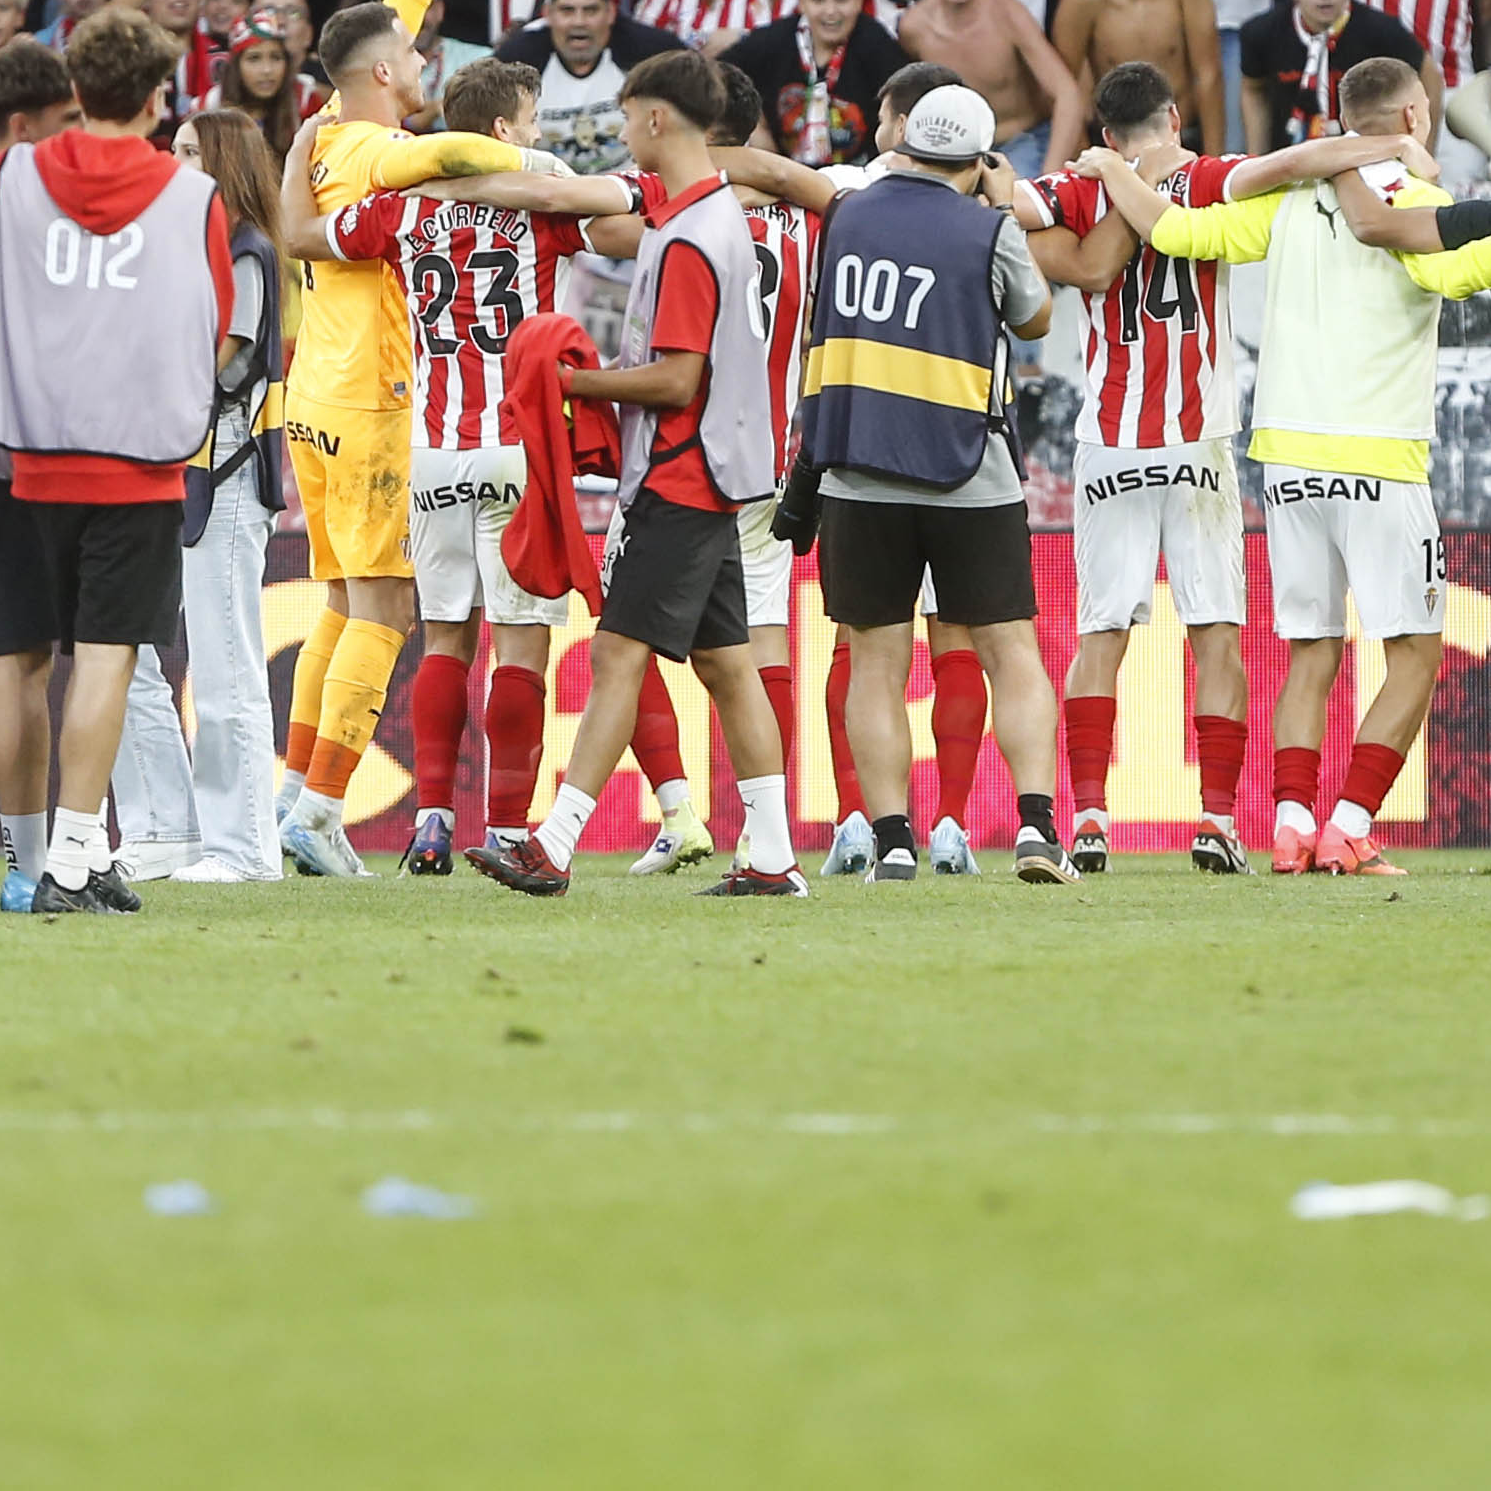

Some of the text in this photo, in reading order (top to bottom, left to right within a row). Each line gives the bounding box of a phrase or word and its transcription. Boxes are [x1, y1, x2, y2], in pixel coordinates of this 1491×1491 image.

[913, 117, 968, 139] BILLABONG
[44, 216, 144, 288] 012
[409, 246, 523, 357] 23
[834, 253, 936, 329] 007
[1119, 242, 1198, 345] 14
[1083, 463, 1220, 505] NISSAN
[1263, 477, 1380, 511] NISSAN
